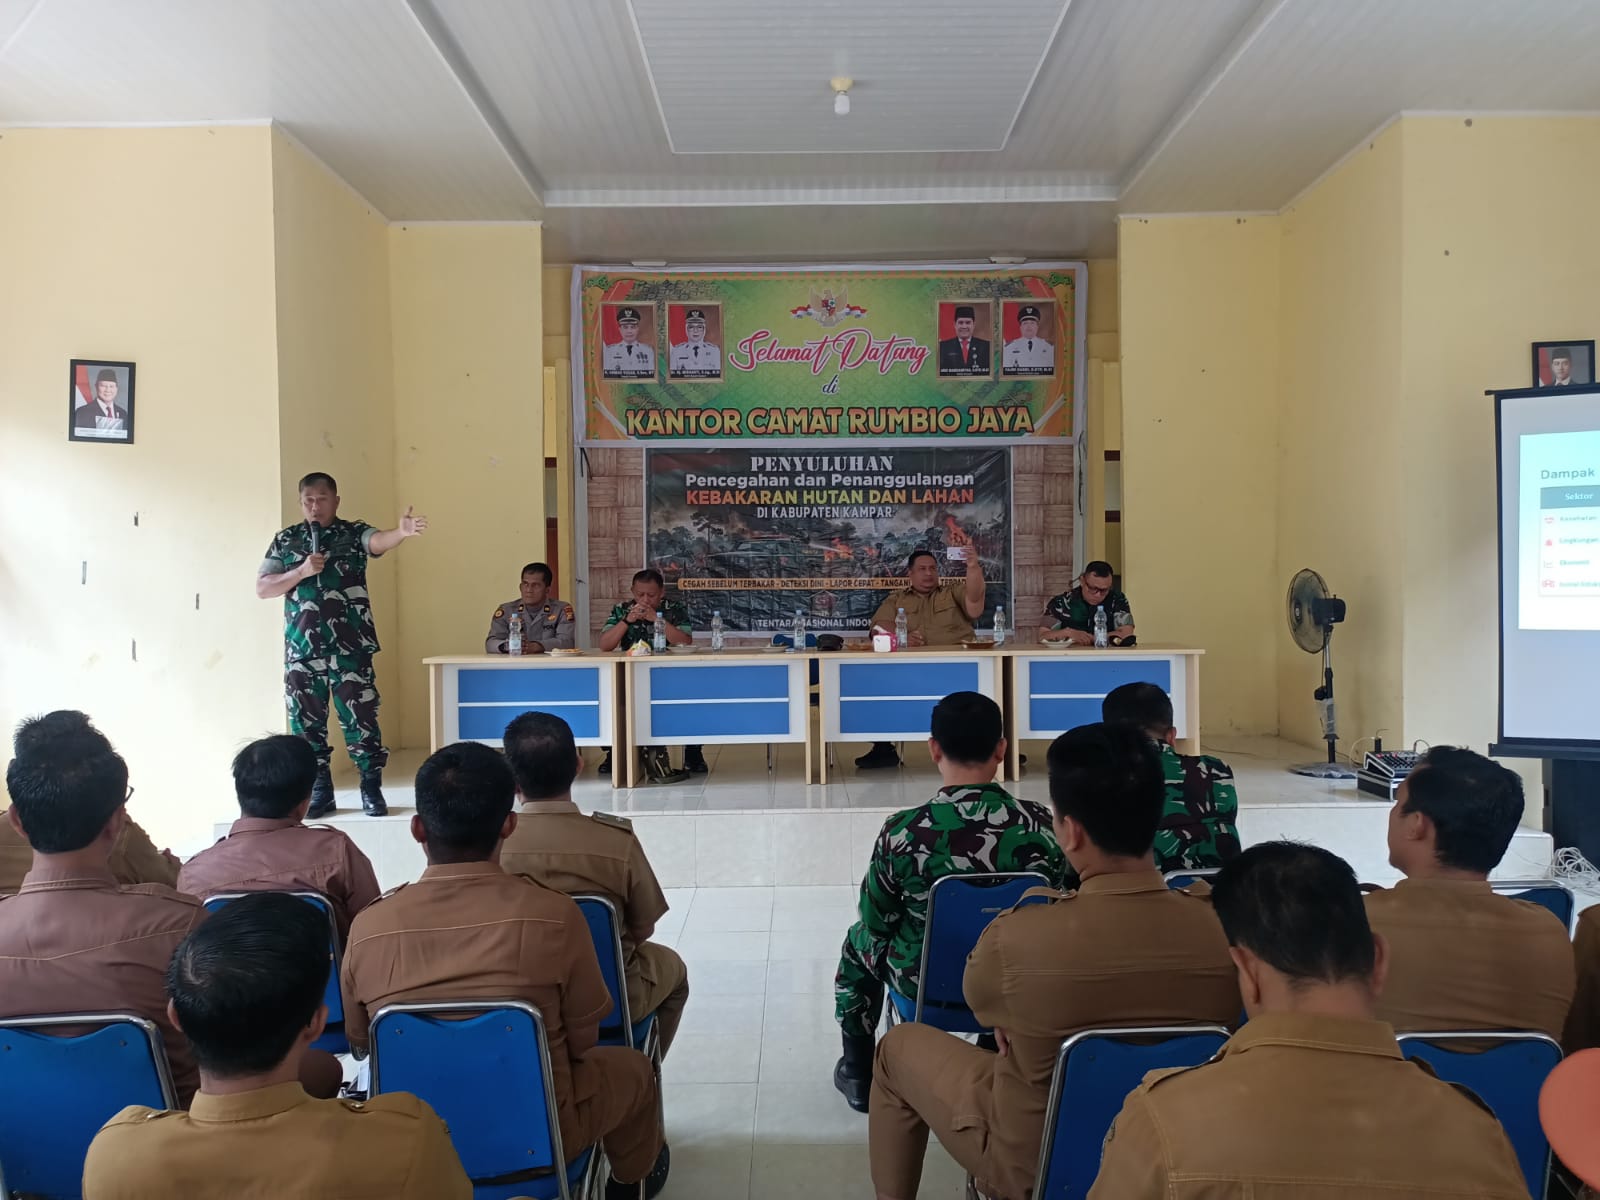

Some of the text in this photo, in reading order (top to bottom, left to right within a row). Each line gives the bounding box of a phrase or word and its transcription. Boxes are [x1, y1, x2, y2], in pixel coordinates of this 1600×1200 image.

[729, 328, 930, 374] Selamat Datang
[822, 375, 839, 394] di
[626, 406, 1034, 436] KANTOR CAMAT RUMBIO JAYA
[750, 455, 894, 472] PENYULUHAN
[685, 472, 974, 489] Pencegahan dan Penanggulangan
[1541, 468, 1595, 480] Dampak
[686, 489, 974, 505] KEBAKARAN HUTAN DAN LAHAN
[1565, 492, 1593, 501] Sektor
[757, 506, 893, 519] DI KABUPATEN KAMPAR
[682, 580, 706, 588] CEGAH
[707, 580, 738, 588] SEBELUM
[739, 580, 775, 588] TERBAKAR
[781, 580, 809, 588] DETEKSI
[810, 580, 824, 588] DINI
[830, 580, 852, 588] LAPOR
[881, 579, 911, 587] TANGANI
[941, 578, 967, 586] TERPAD
